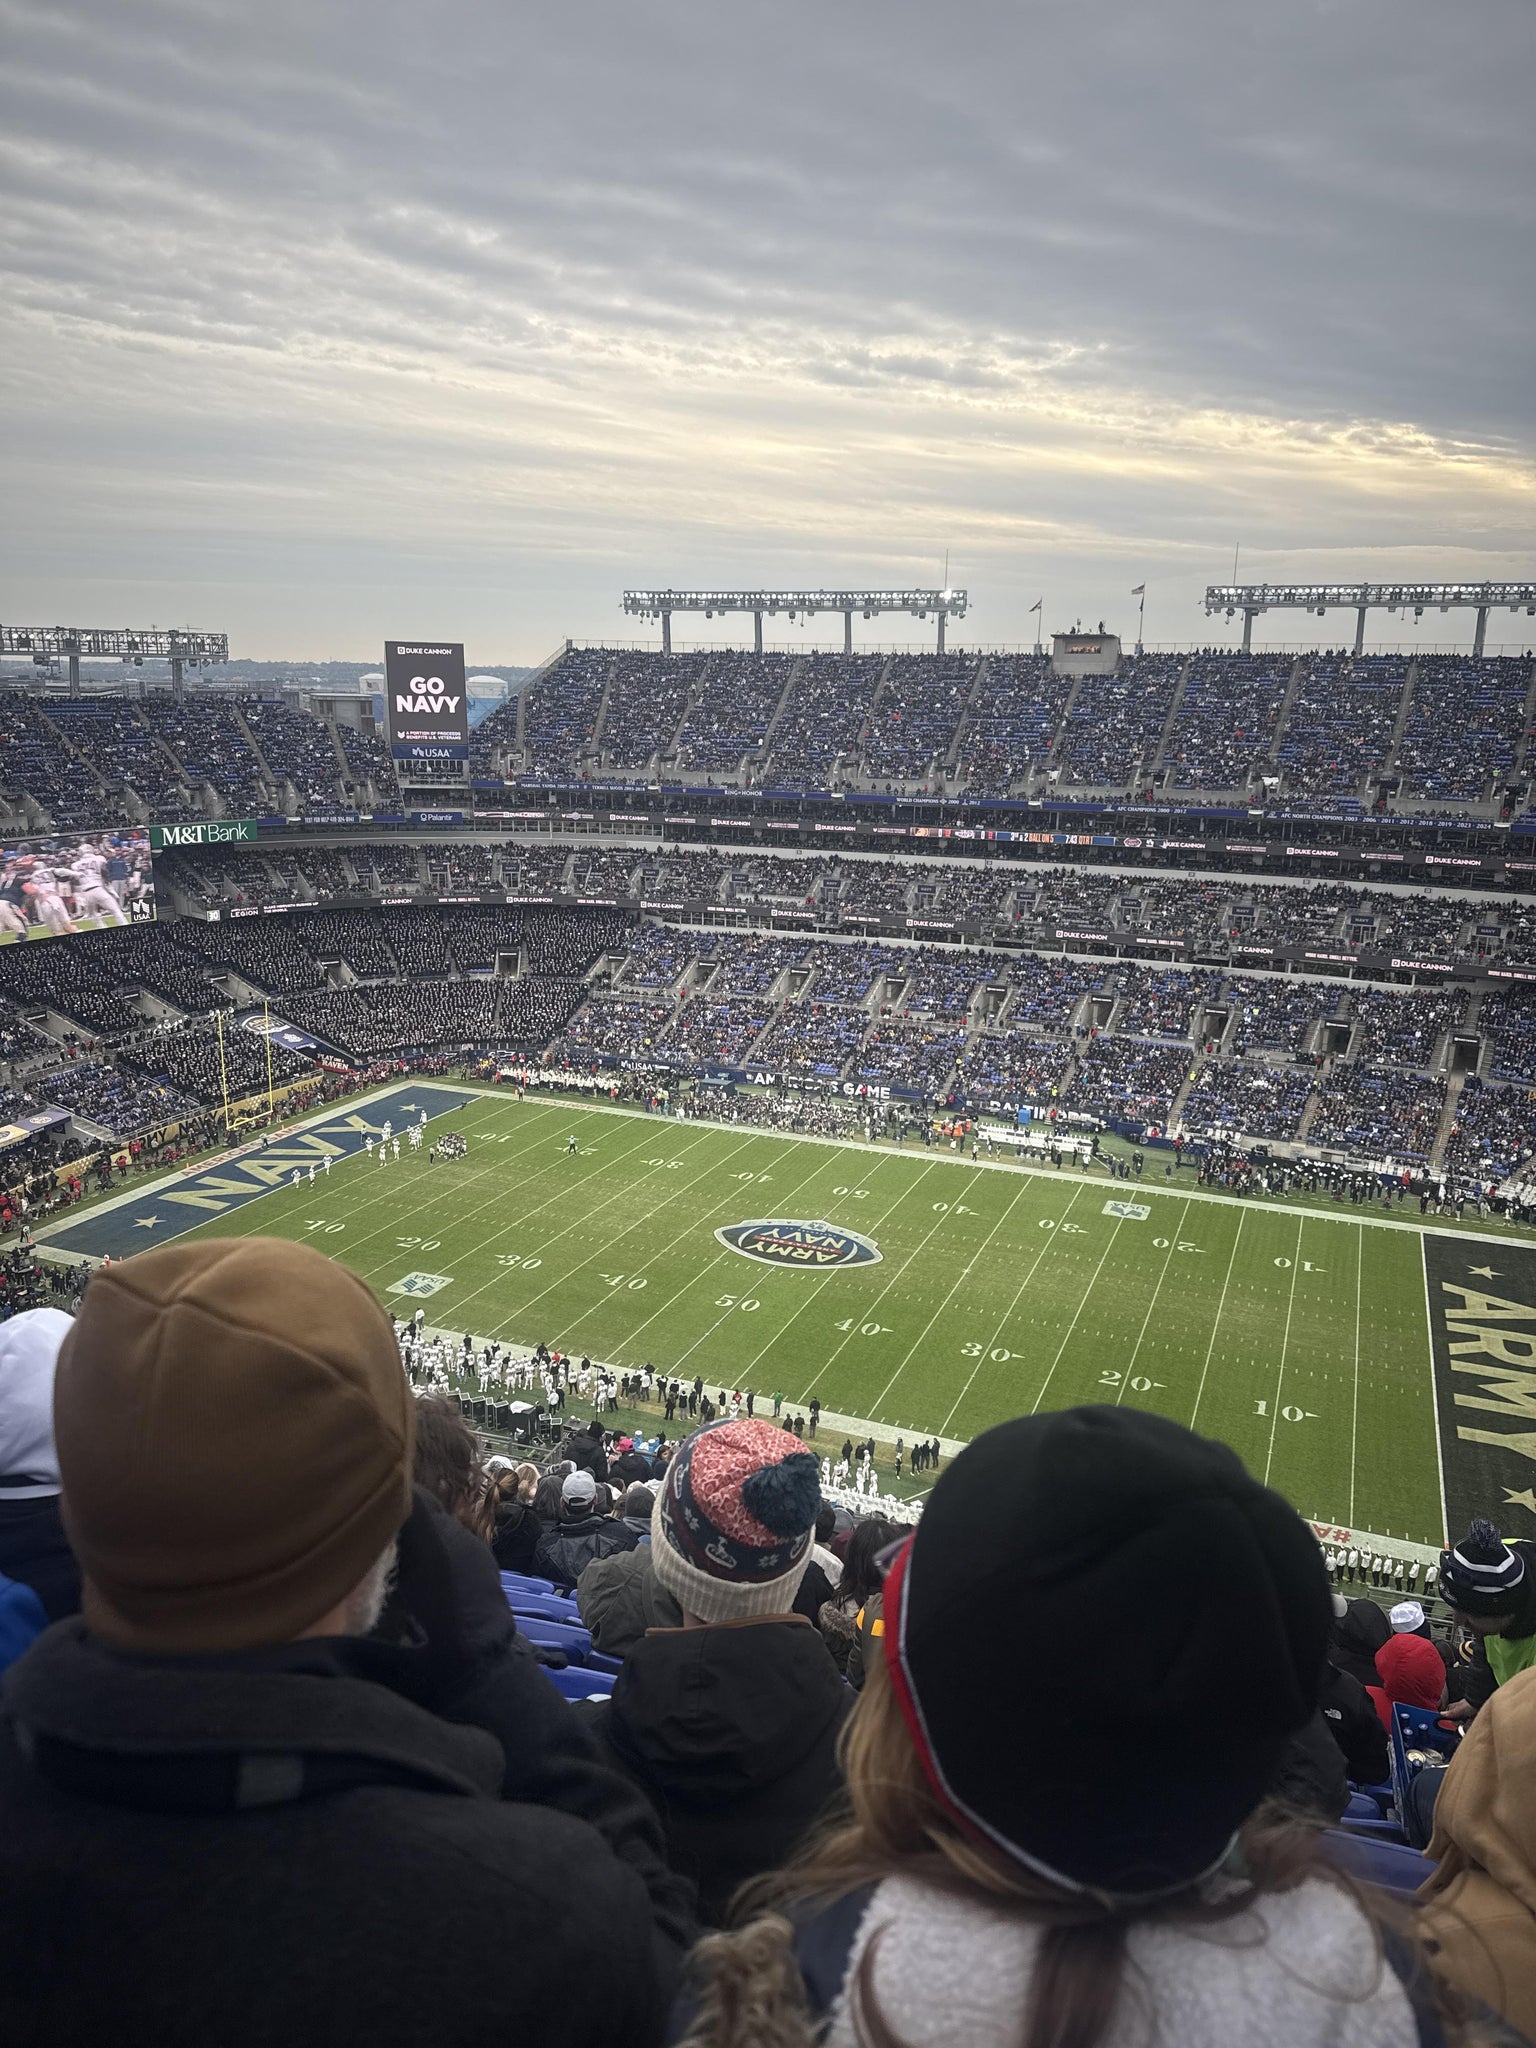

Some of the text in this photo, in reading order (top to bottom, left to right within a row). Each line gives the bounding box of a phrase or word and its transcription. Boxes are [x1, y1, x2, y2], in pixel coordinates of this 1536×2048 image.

[410, 677, 444, 694] GO
[396, 695, 460, 713] NAVY
[425, 749, 450, 758] USAA
[428, 812, 453, 822] Palantir
[162, 824, 248, 846] M&T Bank
[1024, 834, 1028, 842] 2
[1029, 834, 1041, 842] BALL
[1041, 834, 1049, 843] ON
[1065, 835, 1078, 844] 7:43
[1078, 836, 1090, 845] QTR
[1452, 858, 1481, 866] CANNON
[230, 910, 258, 918] LEGION
[1081, 932, 1108, 940] CANNON
[1243, 946, 1273, 954] CANNON
[1421, 962, 1453, 971] CANNON
[322, 1060, 349, 1070] RAVEN
[631, 1062, 653, 1071] USAA
[843, 1083, 890, 1099] GAME
[268, 1124, 306, 1143] GAME
[158, 1115, 394, 1211] NAVY
[649, 1158, 684, 1170] 30
[737, 1172, 773, 1183] 40
[832, 1187, 870, 1199] 50
[932, 1202, 972, 1216] 40
[1112, 1202, 1145, 1211] USAA
[308, 1220, 346, 1234] 10
[1038, 1219, 1079, 1234] 30
[402, 1237, 441, 1251] 20
[761, 1228, 847, 1249] NAVY
[1152, 1238, 1196, 1252] 20
[744, 1241, 838, 1262] ARMY
[498, 1254, 543, 1270] 30
[1274, 1257, 1317, 1272] 10
[414, 1274, 445, 1285] USAA
[605, 1274, 648, 1290] 40
[715, 1294, 761, 1311] 50
[834, 1318, 881, 1336] 40
[961, 1342, 1012, 1362] 30
[1442, 1281, 1536, 1461] ARMY
[1098, 1370, 1153, 1392] 20
[1252, 1400, 1304, 1422] 10
